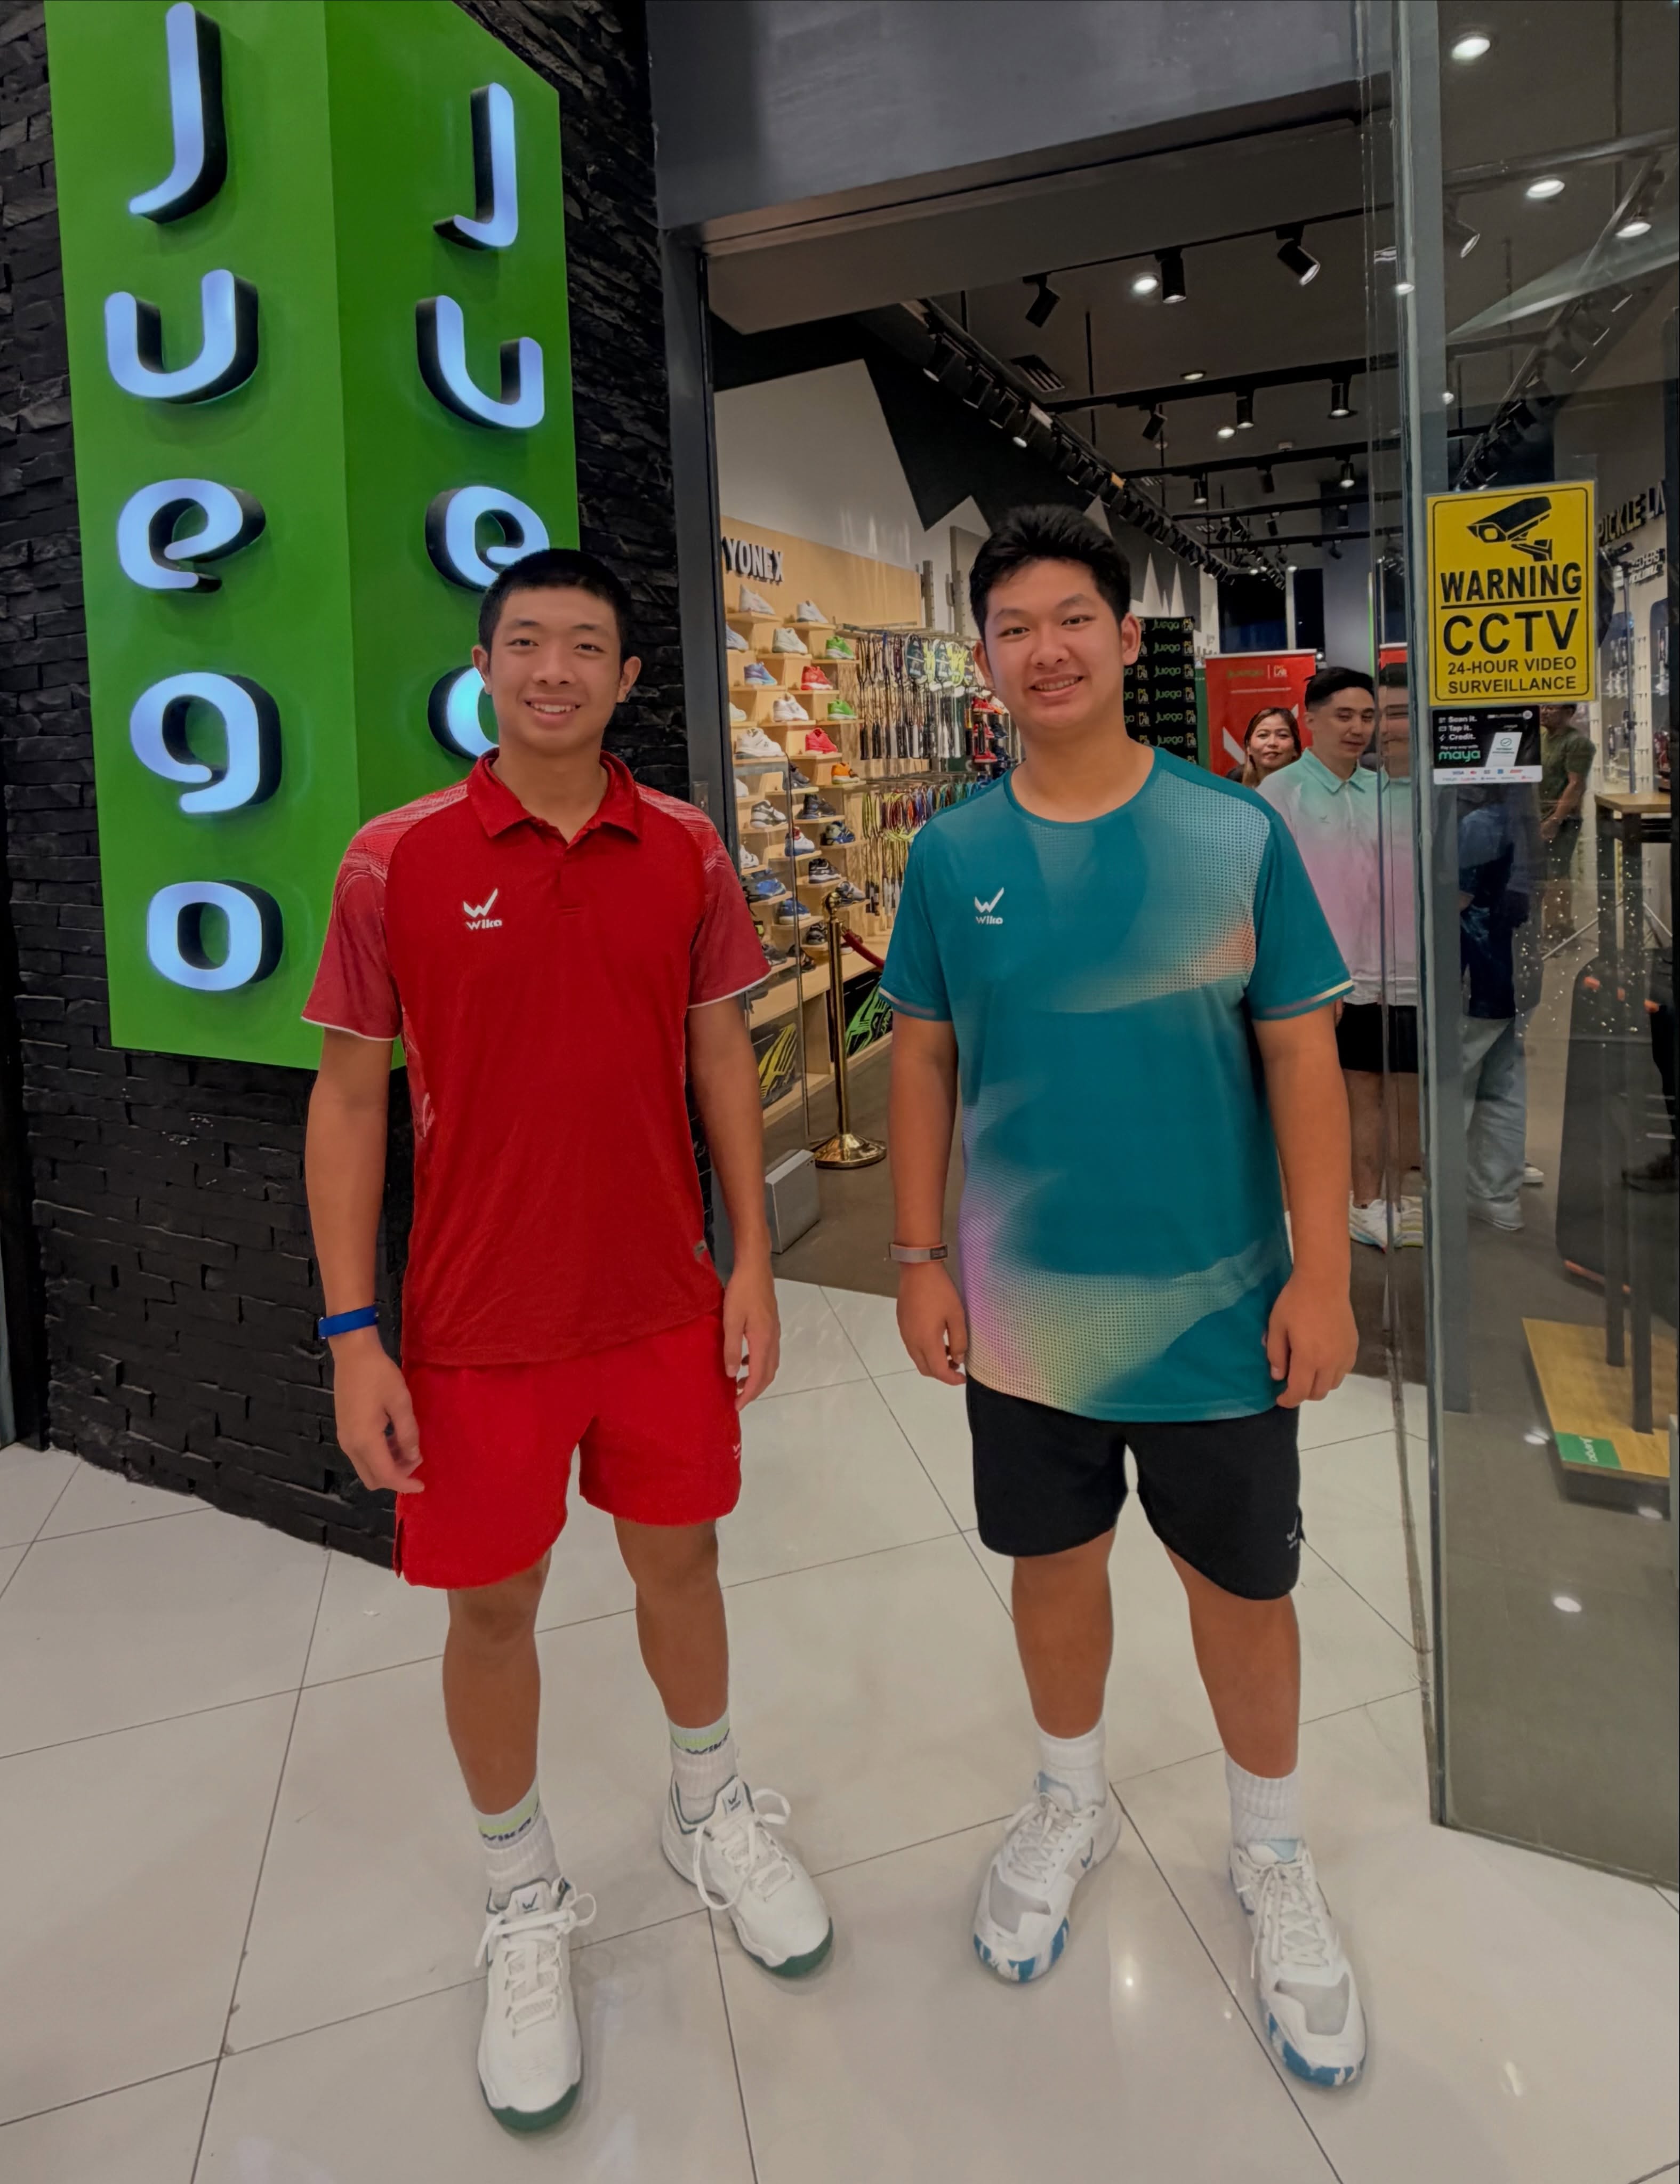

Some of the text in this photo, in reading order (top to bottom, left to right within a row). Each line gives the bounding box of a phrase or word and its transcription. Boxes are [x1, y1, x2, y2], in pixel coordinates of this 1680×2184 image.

[435, 83, 549, 757] Jue
[1597, 495, 1642, 542] PICKLE
[1645, 480, 1666, 520] LA
[725, 535, 784, 582] YONEX
[1440, 562, 1582, 603] WARNING
[1443, 608, 1579, 656] CCTV
[1448, 656, 1577, 675] 24-HOUR VIDEO
[1448, 676, 1577, 694] SURVEILLANCE
[1438, 750, 1481, 762] maya
